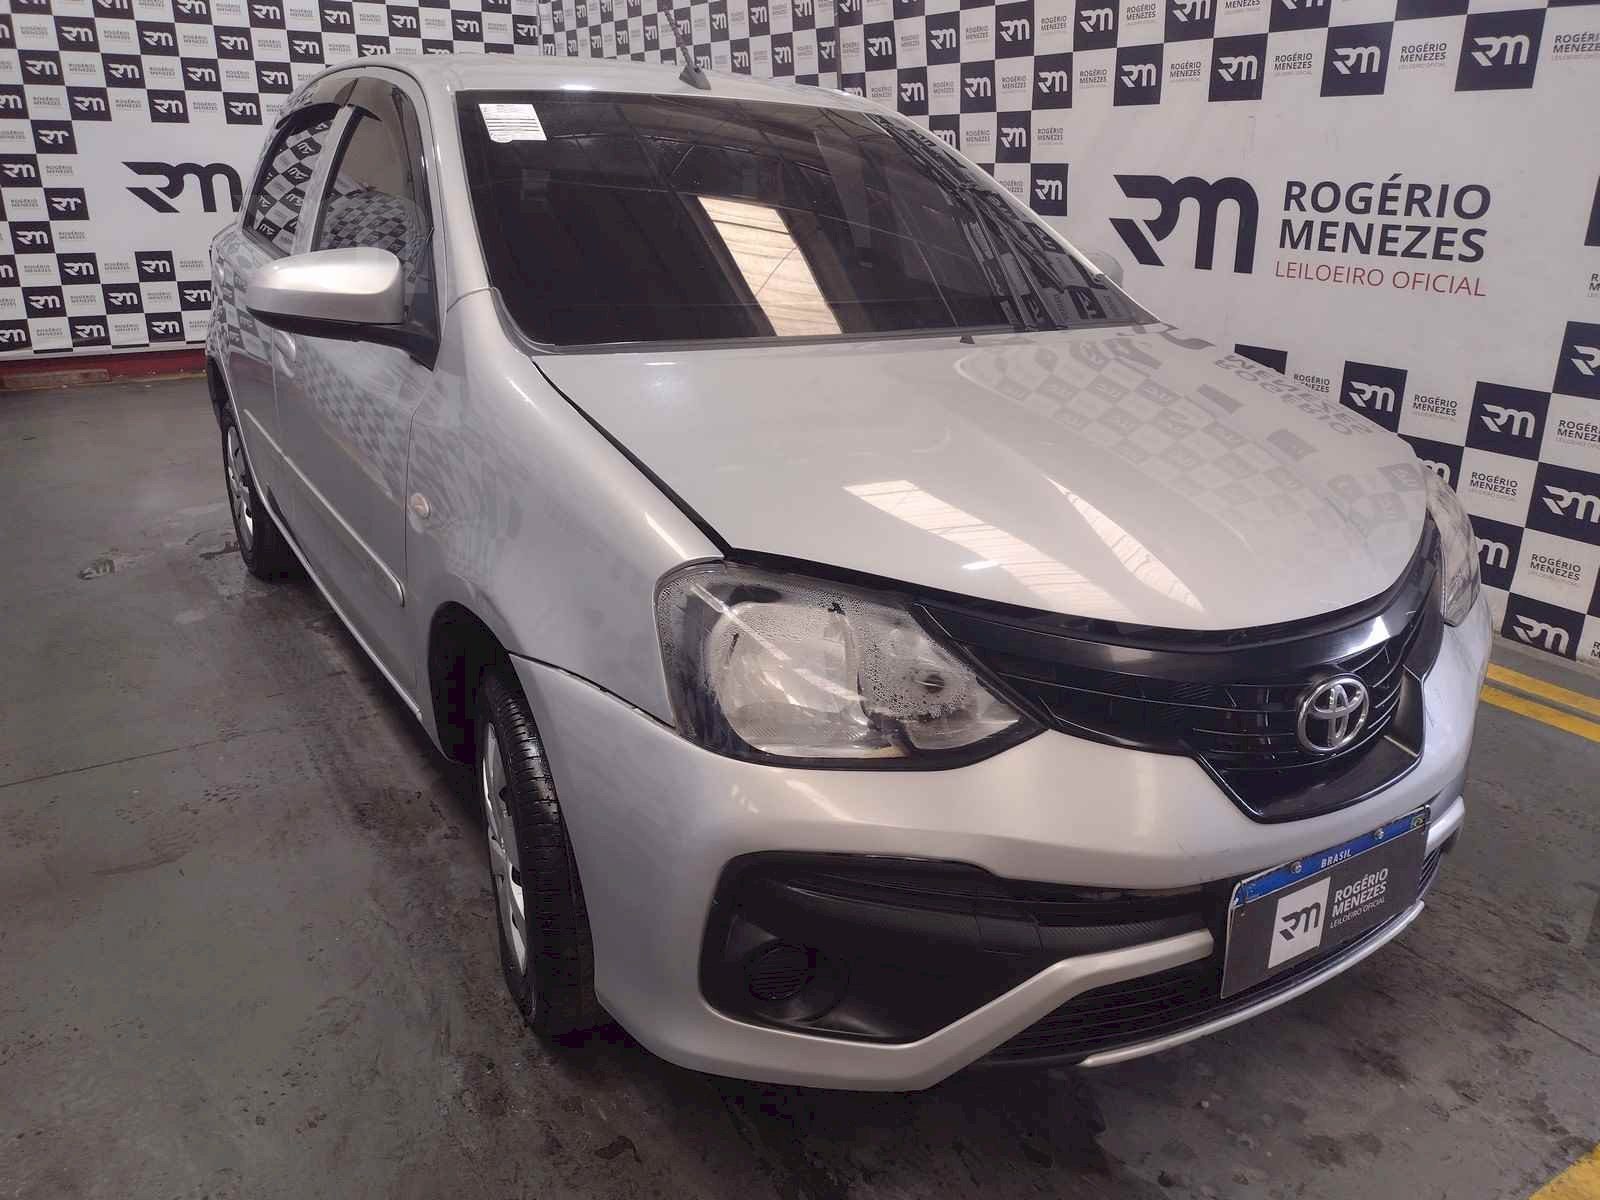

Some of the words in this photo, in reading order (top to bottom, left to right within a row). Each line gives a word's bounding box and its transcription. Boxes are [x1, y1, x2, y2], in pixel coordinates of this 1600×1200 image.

[1554, 31, 1600, 43] ROGÉRI
[1401, 41, 1447, 54] ROGÉRIO
[1552, 42, 1600, 54] MENEZE
[1274, 51, 1313, 62] ROGÉRIO
[1400, 51, 1446, 63] MENEZES
[1274, 60, 1312, 71] MENEZES
[1283, 173, 1491, 220] ROGÉRIO
[1279, 219, 1488, 263] MENEZES
[1275, 260, 1384, 287] LEILOEIRO
[1392, 271, 1487, 297] OFICIAL
[1294, 374, 1330, 386] ROGÉRIO
[1414, 394, 1458, 409] ROGÉRIO
[1412, 402, 1457, 417] MENEZES
[1559, 420, 1600, 433] ROGÉR
[1557, 428, 1600, 442] MENEZ
[1471, 471, 1518, 488] ROGÉRIO
[1470, 480, 1517, 496] MENEZES
[1531, 554, 1581, 573] ROGÉRIO
[1530, 562, 1580, 581] MENEZES
[1321, 849, 1351, 868] BRASIL
[1335, 868, 1388, 903] ROGÉRIO
[1332, 881, 1387, 917] MENEZES
